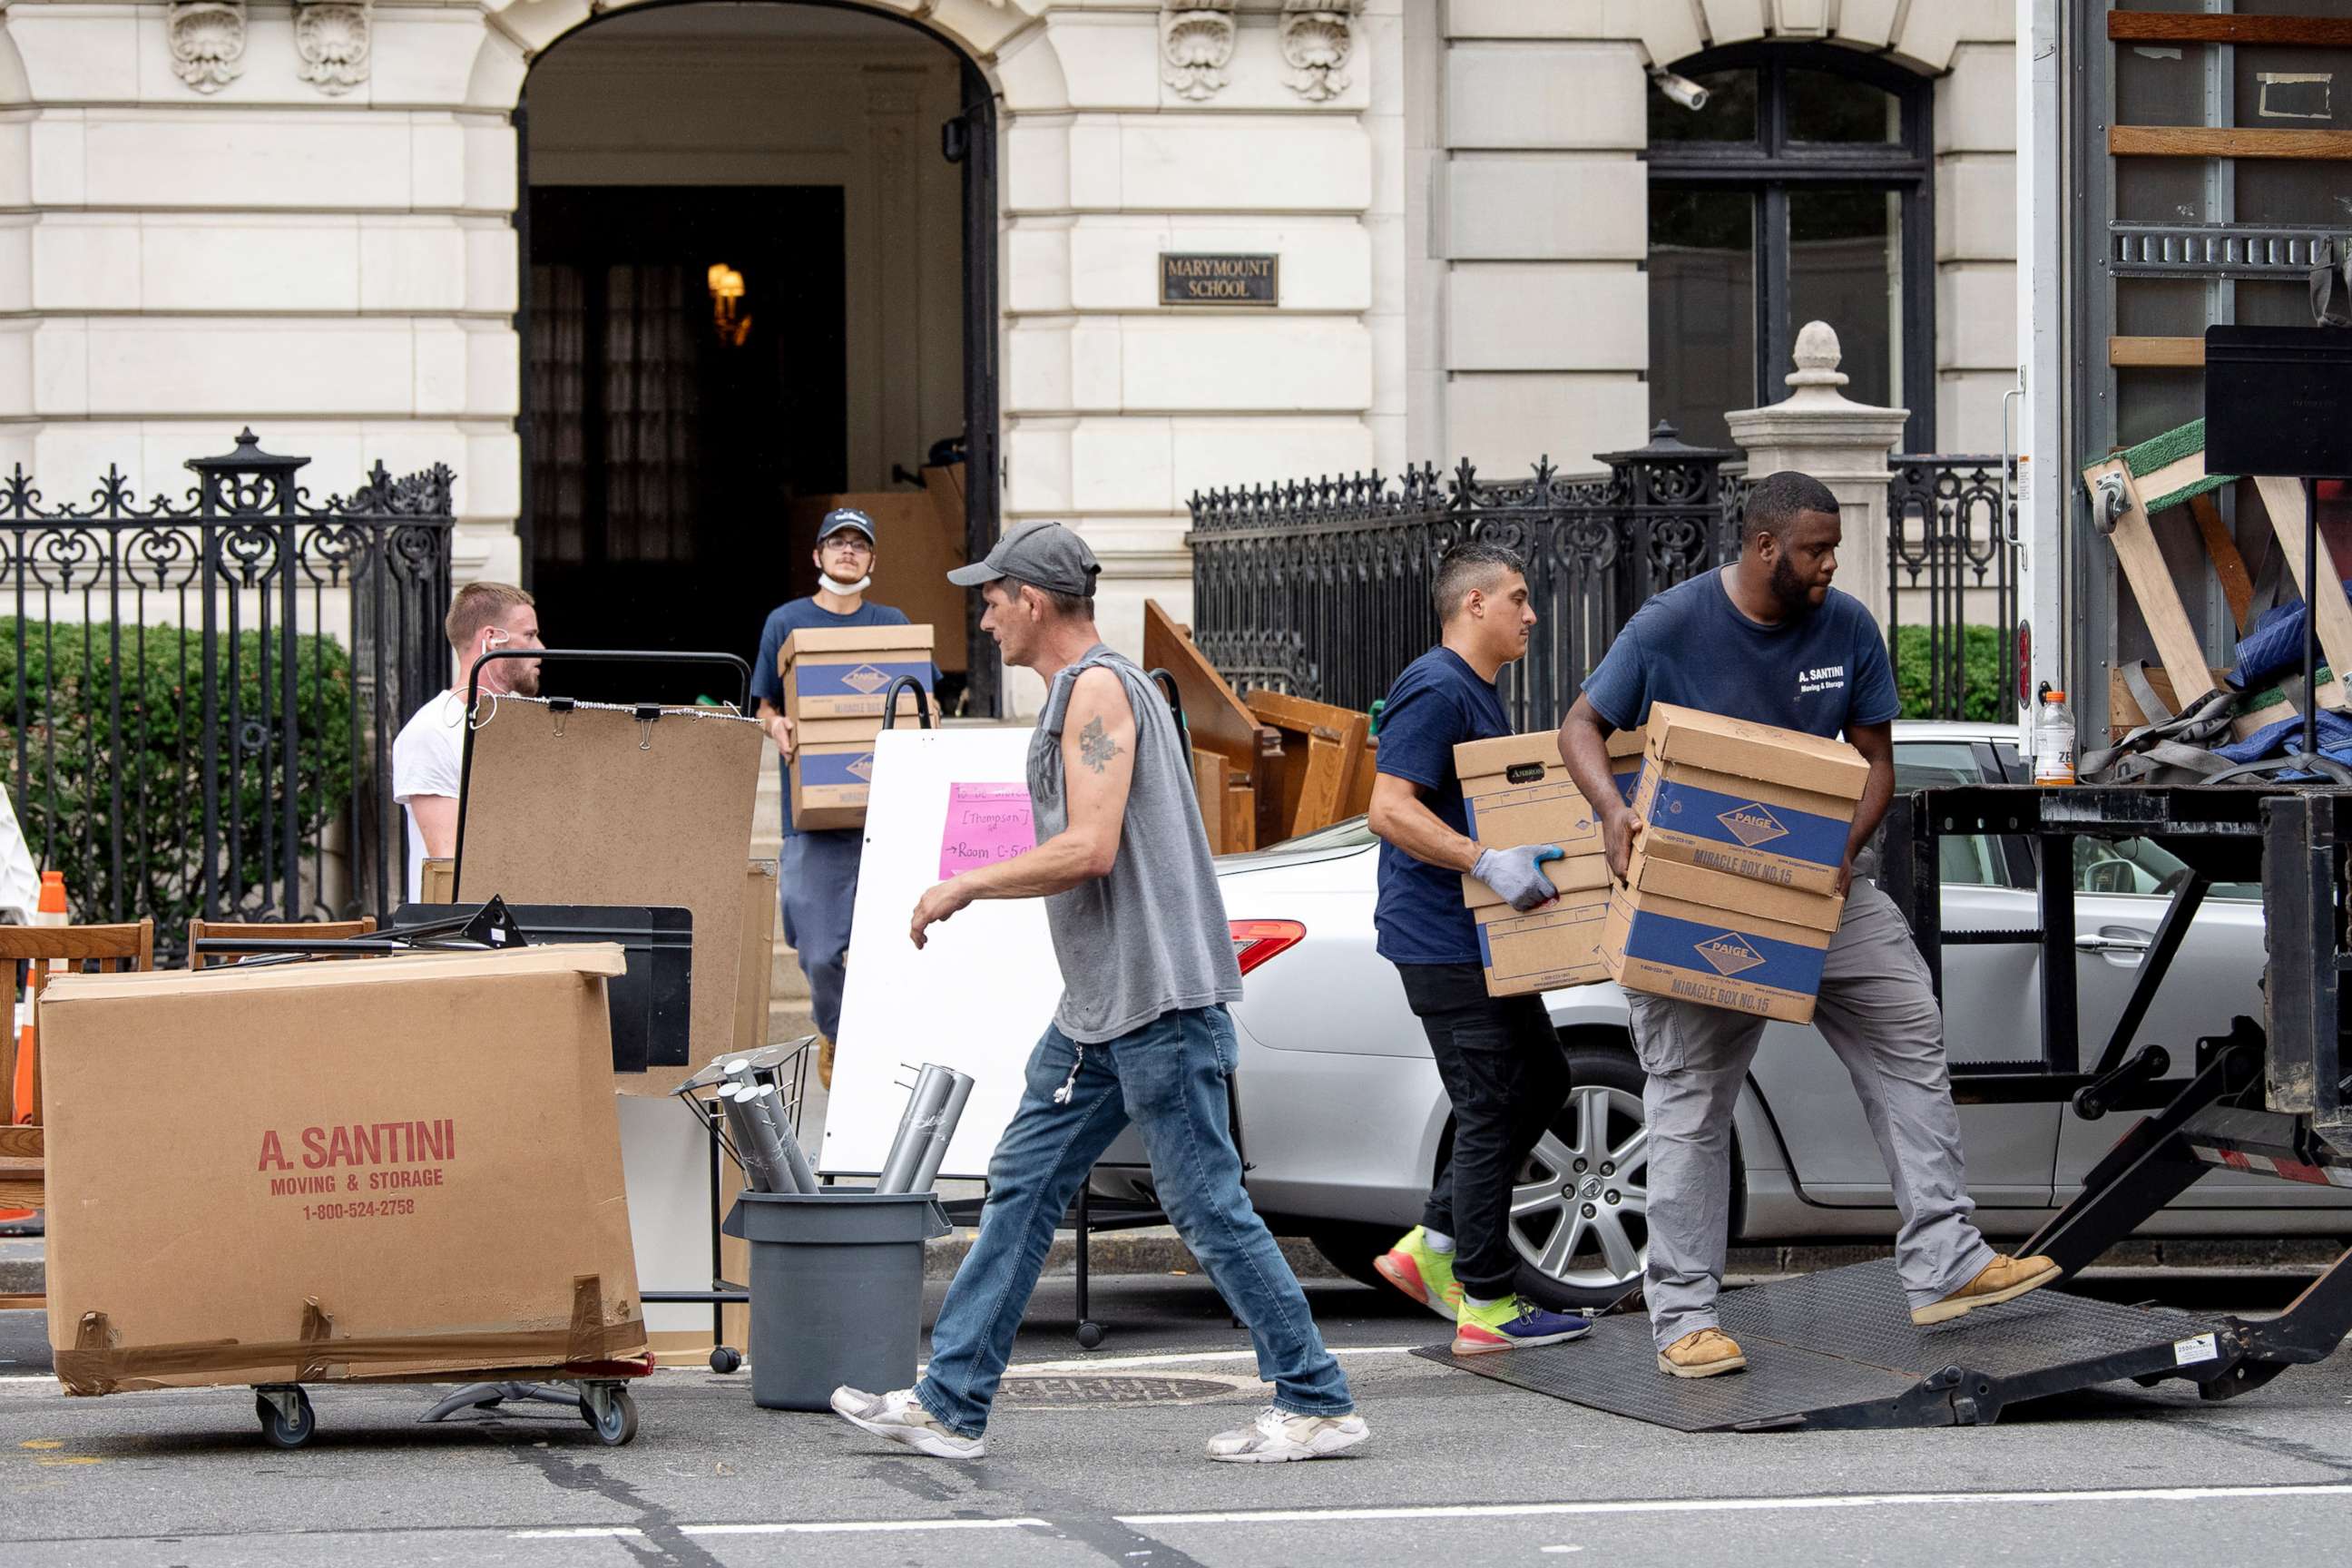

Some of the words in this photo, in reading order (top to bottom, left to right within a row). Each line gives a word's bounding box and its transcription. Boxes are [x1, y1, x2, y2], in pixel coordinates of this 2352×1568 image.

[1168, 260, 1269, 277] MARYMOUNT
[1189, 279, 1250, 298] SCHOOL
[1799, 671, 1808, 682] A.
[1809, 666, 1843, 681] SANTINI
[1735, 813, 1772, 828] PAIGE
[958, 841, 989, 859] Room
[1693, 848, 1738, 871] MIRACLE
[1739, 859, 1761, 877] BOX
[1761, 864, 1778, 880] NO.
[1779, 868, 1793, 884] 15
[1712, 942, 1749, 958] PAIGE
[1671, 978, 1716, 1002] MIRACLE
[1717, 989, 1739, 1006] BOX
[1739, 993, 1755, 1010] NO.
[1757, 998, 1770, 1013] 15
[259, 1130, 294, 1171] A.
[301, 1119, 456, 1170] SANTINI
[270, 1175, 336, 1196] MOVING
[347, 1174, 359, 1191] &
[369, 1169, 444, 1191] STORAGE
[302, 1199, 415, 1220] 1-800-524-2758
